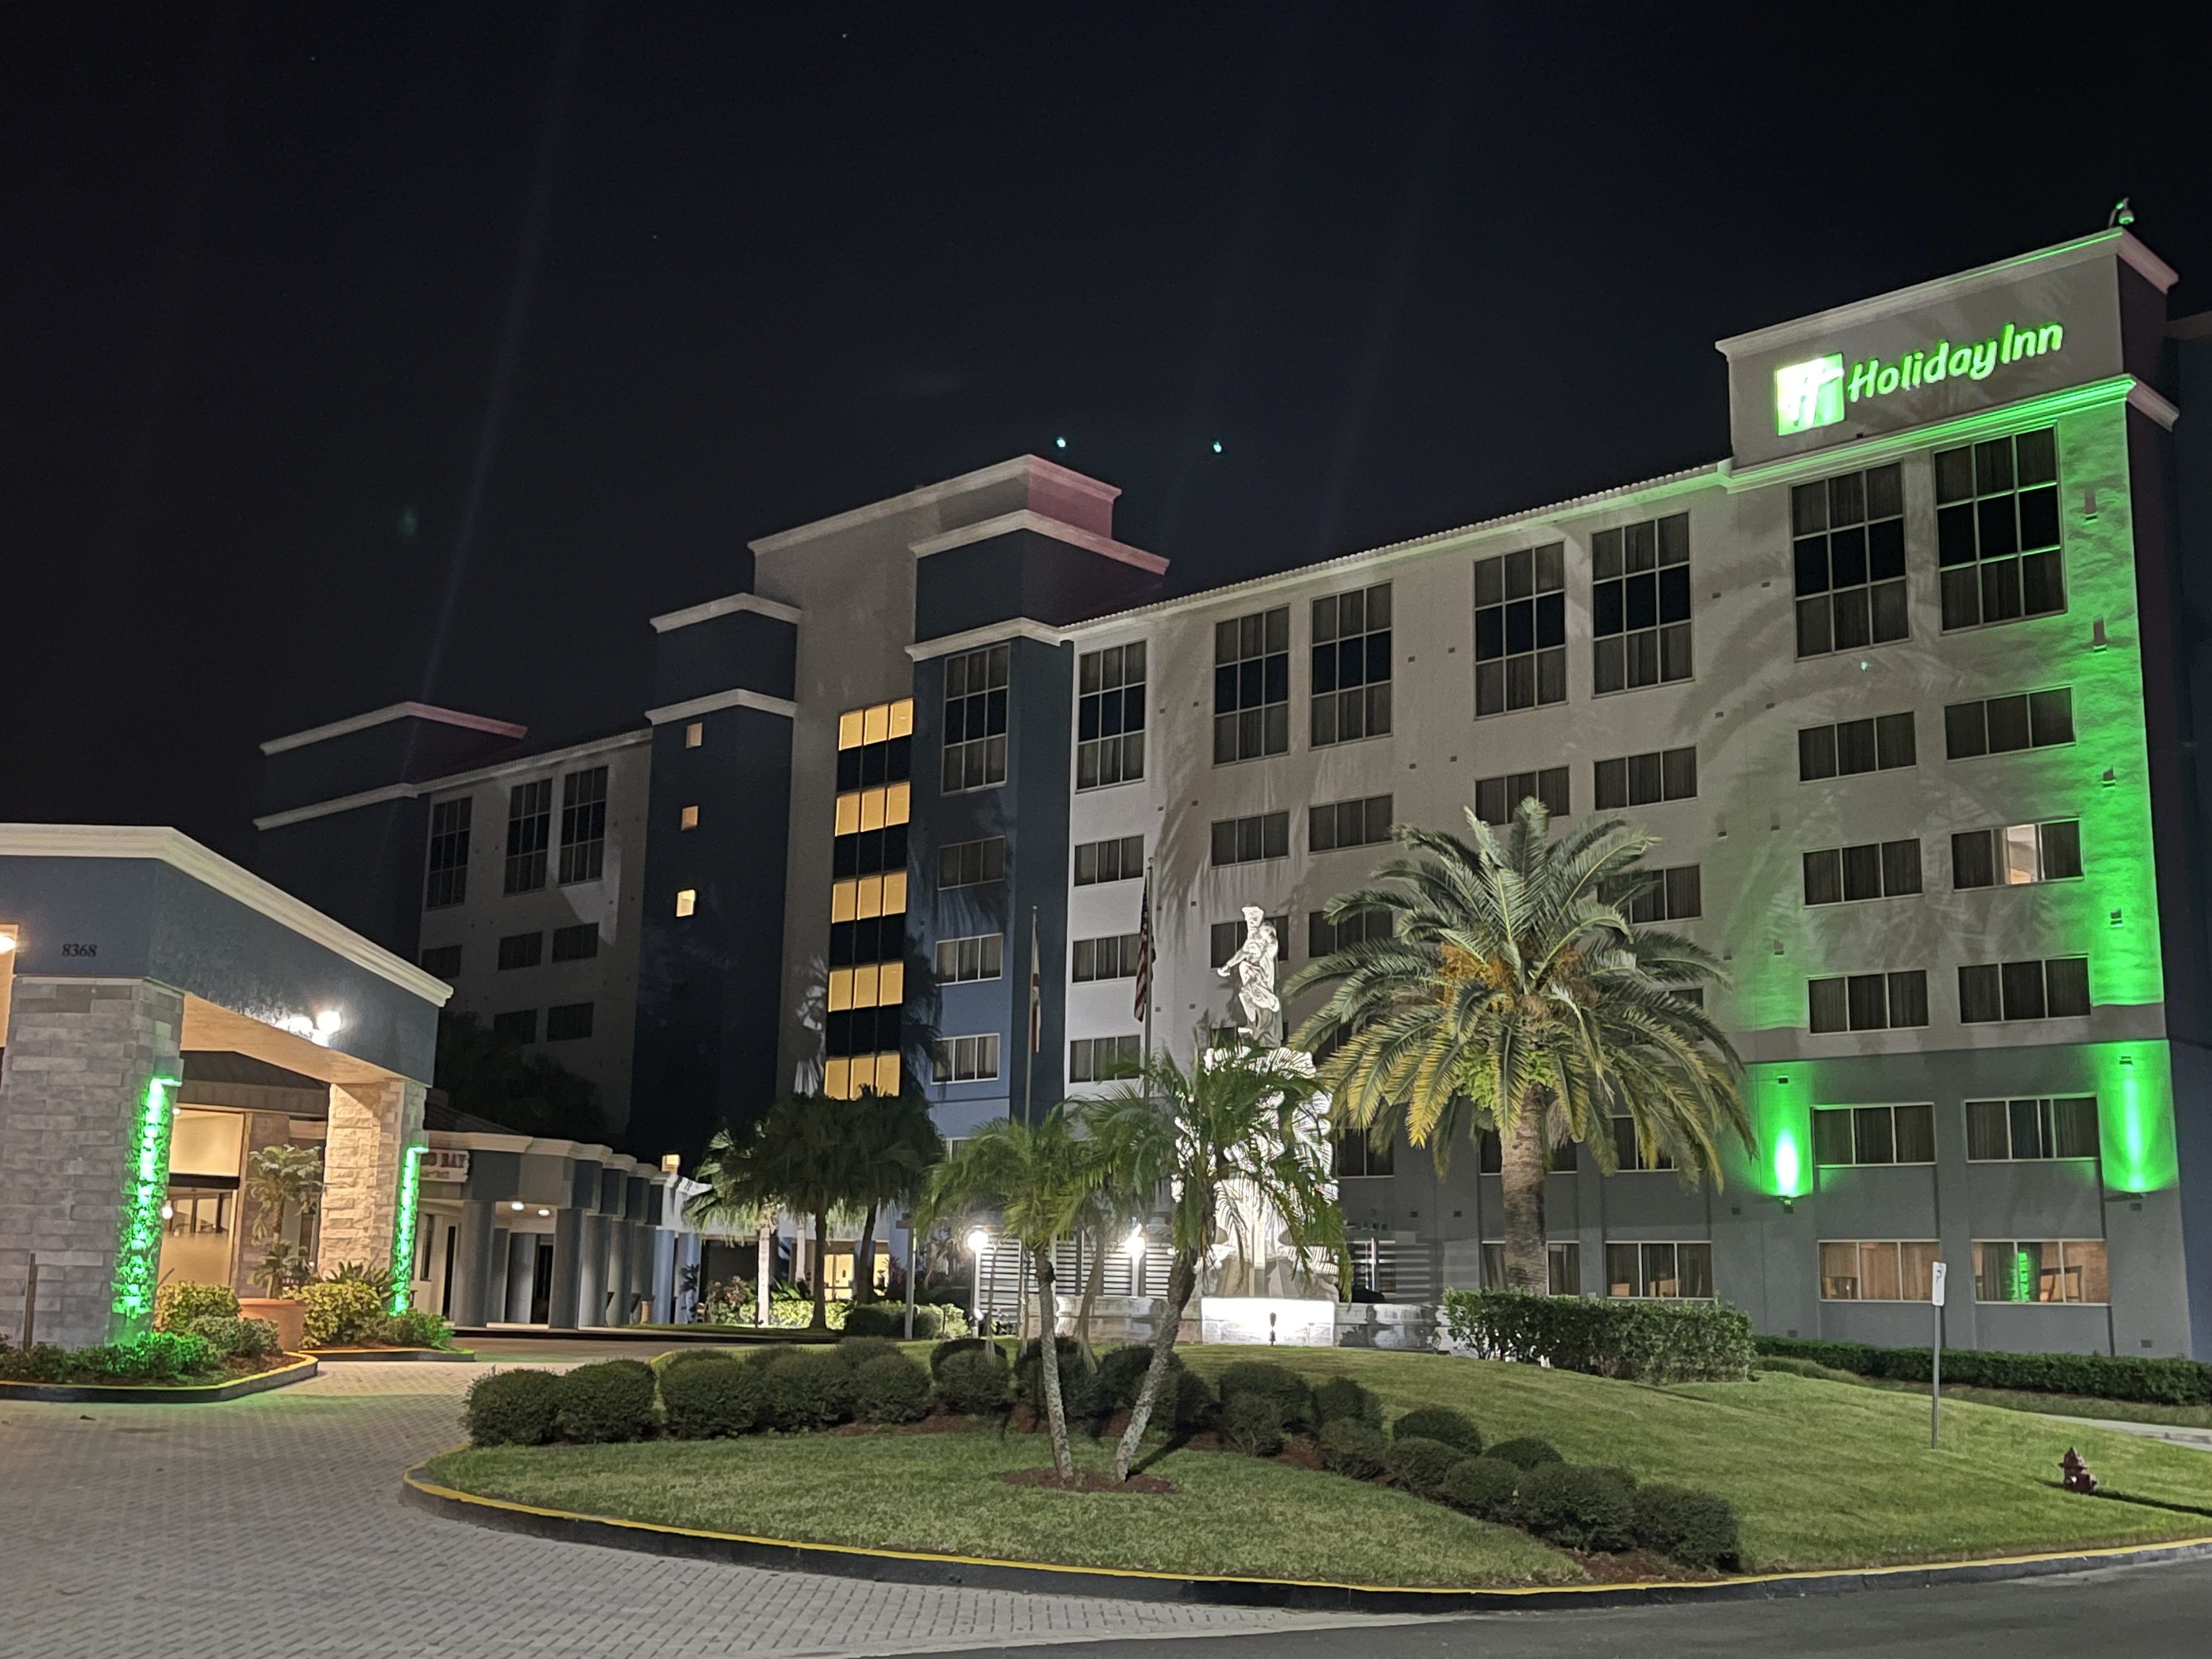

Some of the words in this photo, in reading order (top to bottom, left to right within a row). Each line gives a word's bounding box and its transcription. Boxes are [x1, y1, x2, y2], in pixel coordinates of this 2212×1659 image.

[1847, 340, 1997, 403] Holiday
[2000, 323, 2063, 364] Inn
[62, 943, 97, 957] 8368
